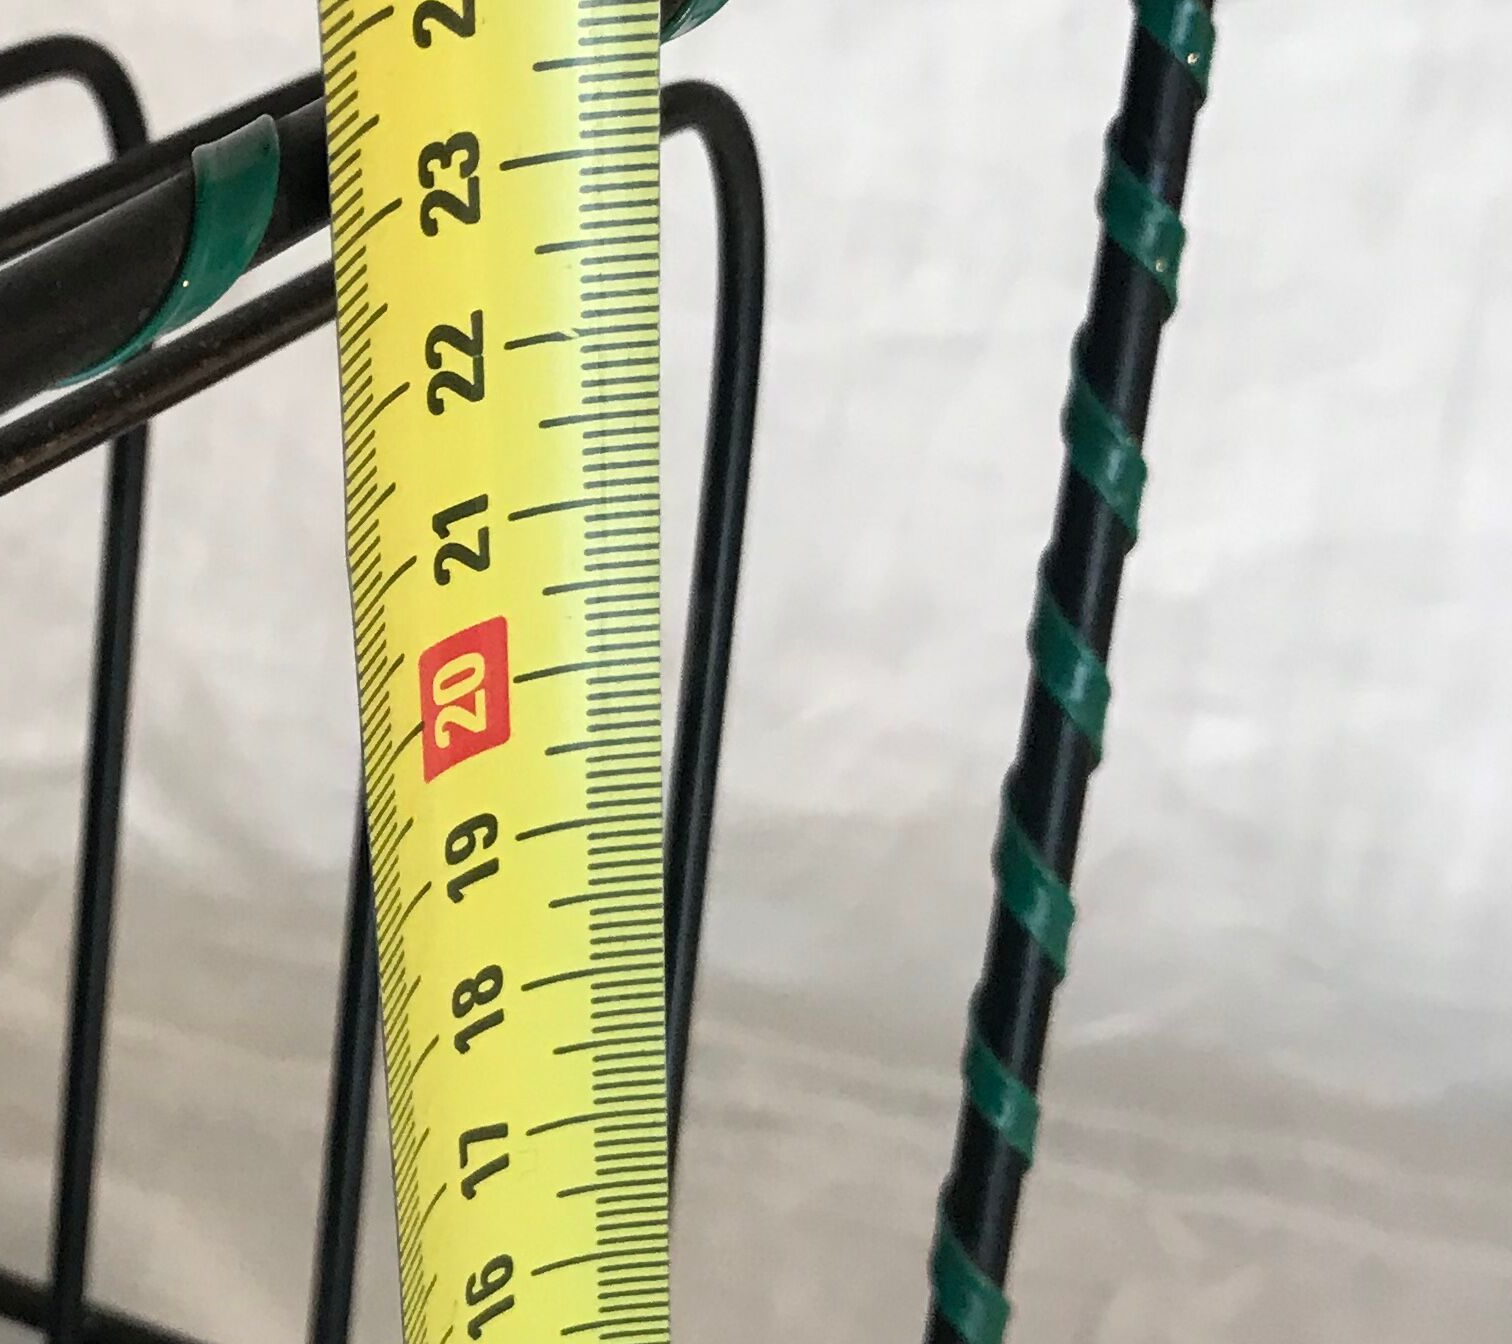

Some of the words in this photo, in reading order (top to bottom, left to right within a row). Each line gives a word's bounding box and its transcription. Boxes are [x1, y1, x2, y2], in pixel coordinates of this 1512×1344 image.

[418, 131, 481, 237] 23
[425, 309, 485, 416] 22
[432, 493, 490, 586] 21
[432, 651, 488, 749] 20
[445, 813, 500, 904] 19
[452, 964, 504, 1054] 18
[459, 1122, 510, 1200] 17
[466, 1254, 515, 1340] 16
